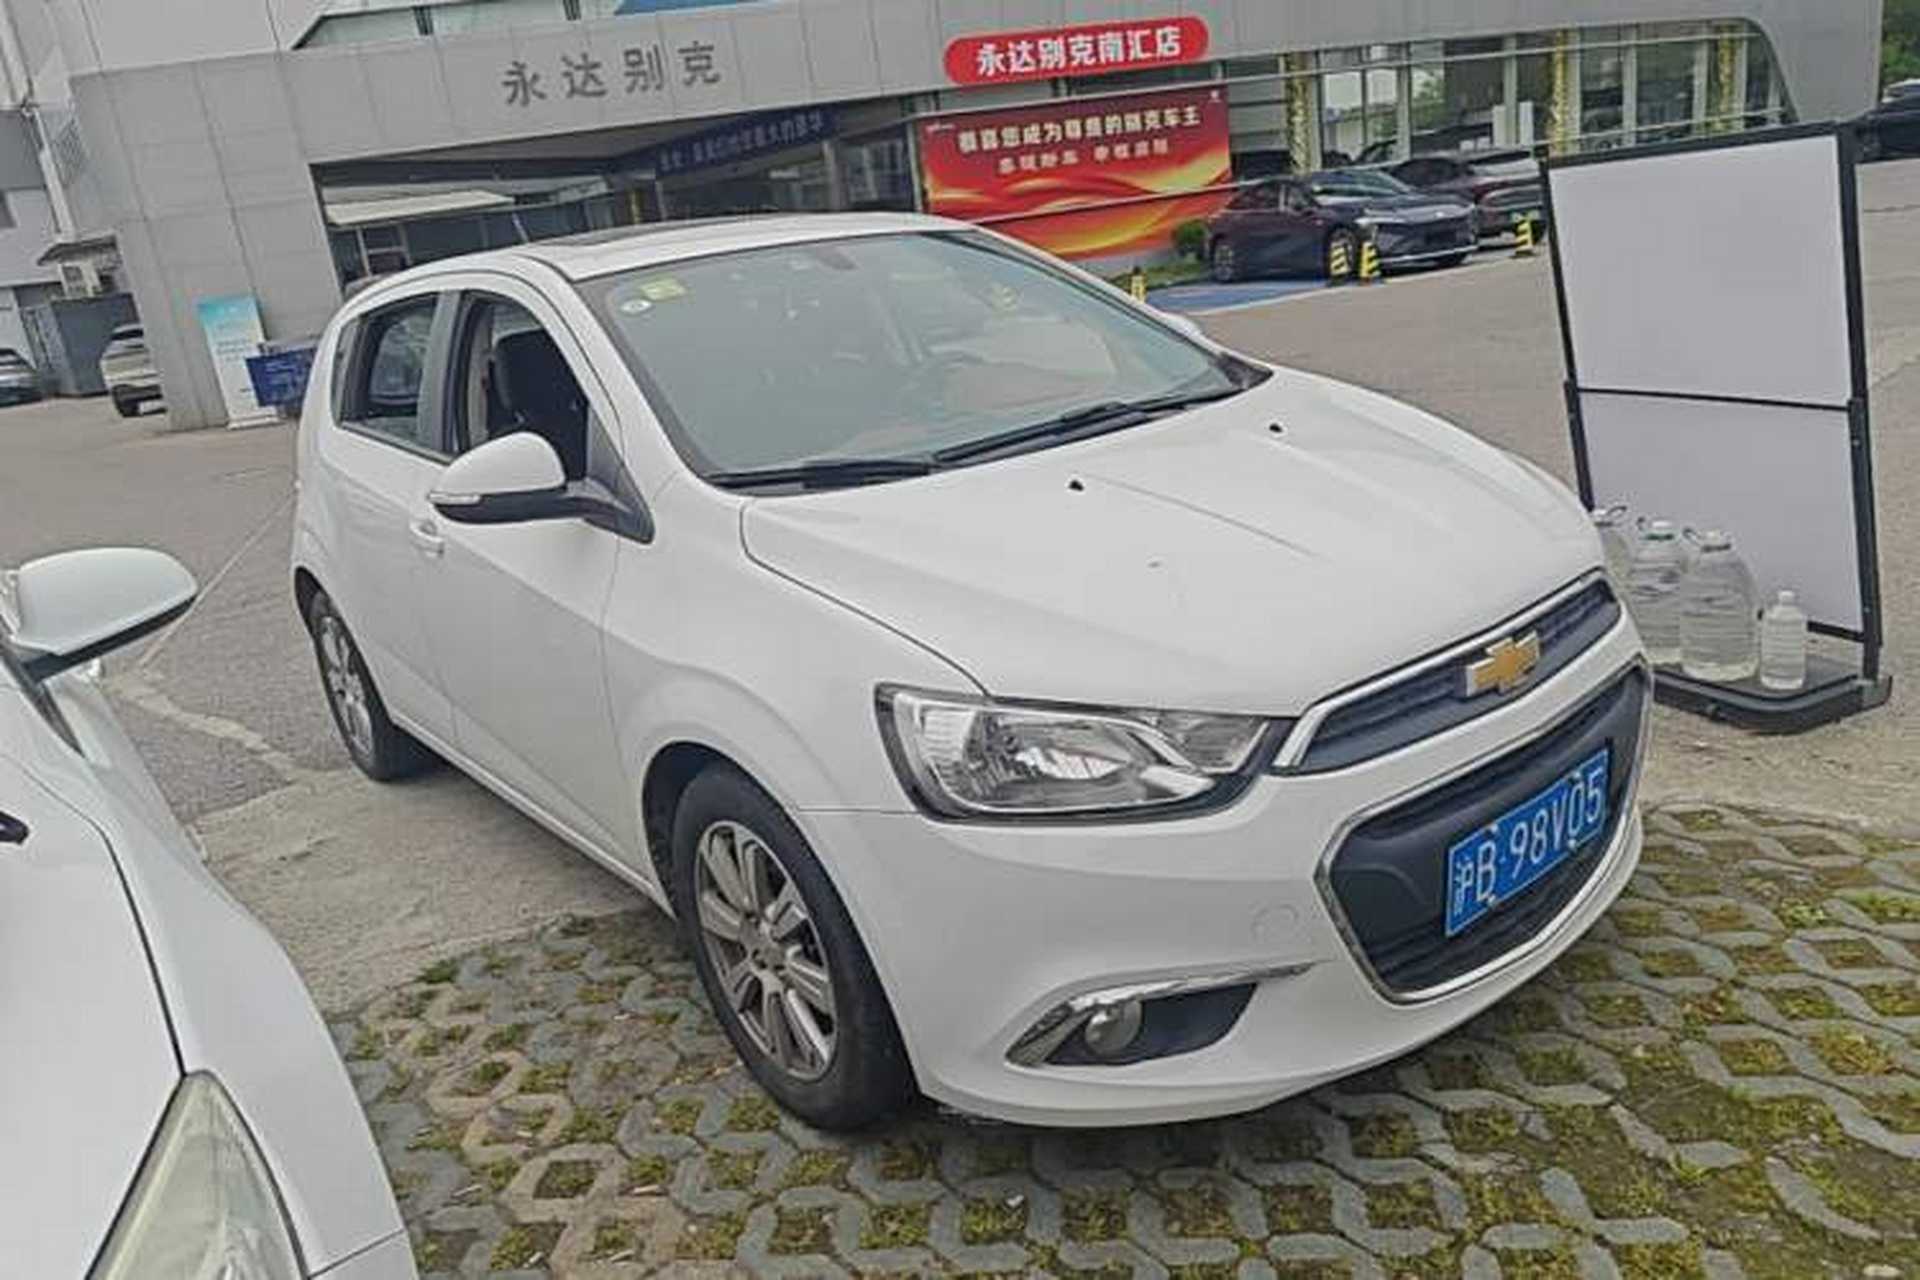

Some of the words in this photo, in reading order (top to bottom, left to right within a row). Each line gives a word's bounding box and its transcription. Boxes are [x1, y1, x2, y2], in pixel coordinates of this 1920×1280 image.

[502, 41, 720, 106] 永达别克
[976, 26, 1181, 76] 永达别克南汇店
